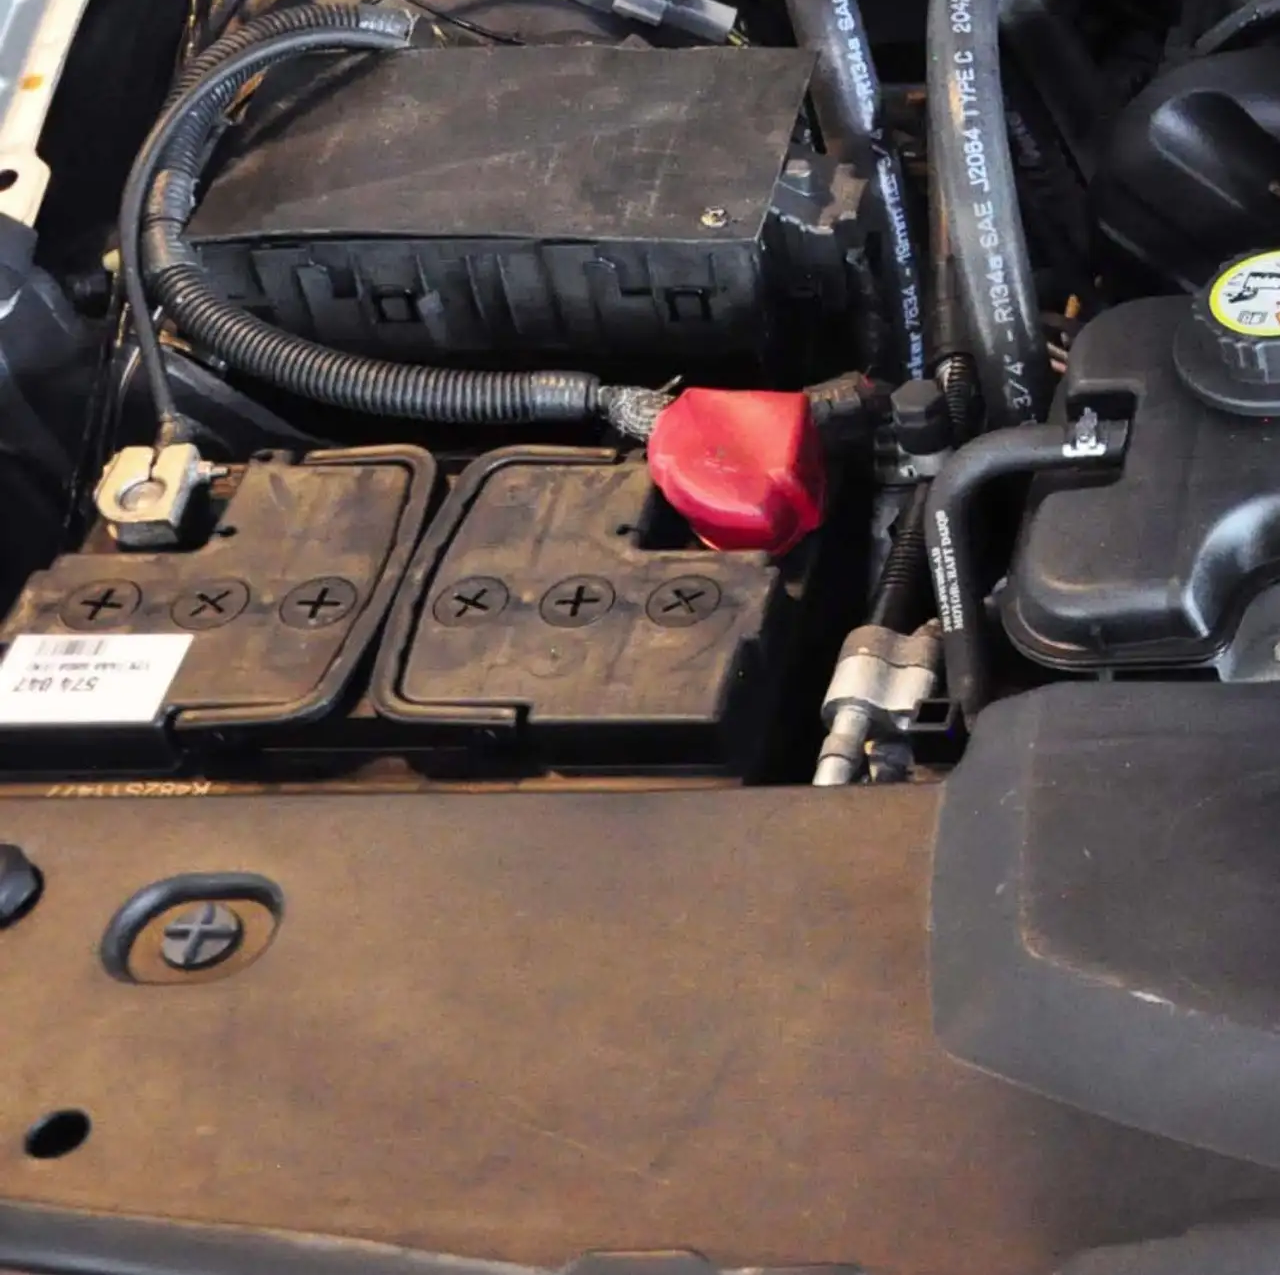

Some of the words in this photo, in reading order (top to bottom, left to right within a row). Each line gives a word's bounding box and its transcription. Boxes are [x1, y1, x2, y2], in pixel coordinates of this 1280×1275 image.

[847, 37, 874, 96] R134a
[956, 50, 974, 64] C
[955, 68, 980, 118] TYPE
[974, 201, 999, 249] SAE
[988, 255, 1016, 323] R134a
[60, 676, 99, 693] 574
